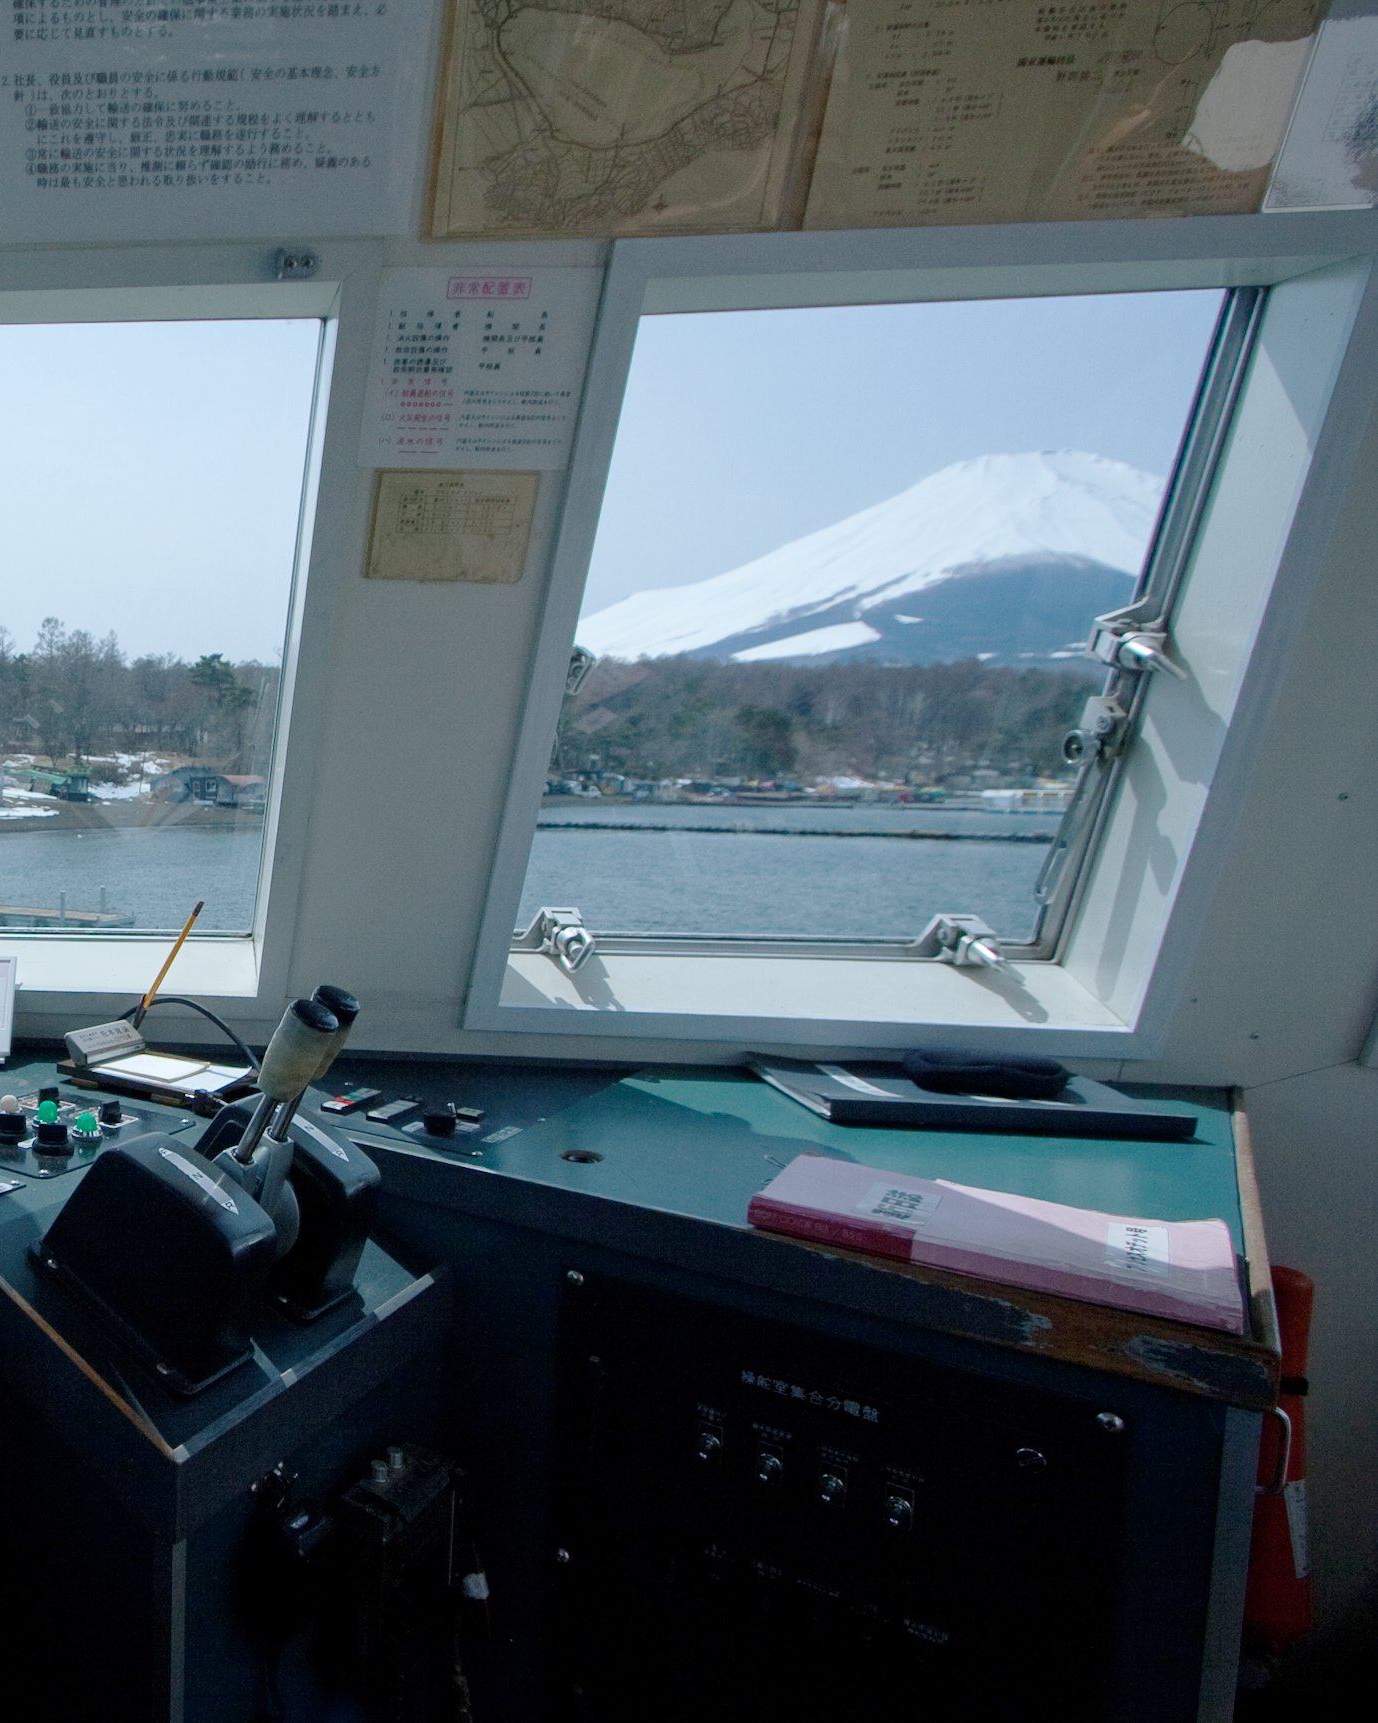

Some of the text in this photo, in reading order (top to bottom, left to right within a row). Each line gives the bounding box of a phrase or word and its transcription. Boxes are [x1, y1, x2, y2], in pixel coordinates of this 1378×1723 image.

[453, 281, 528, 295] 非常配置表
[191, 1171, 203, 1180] N
